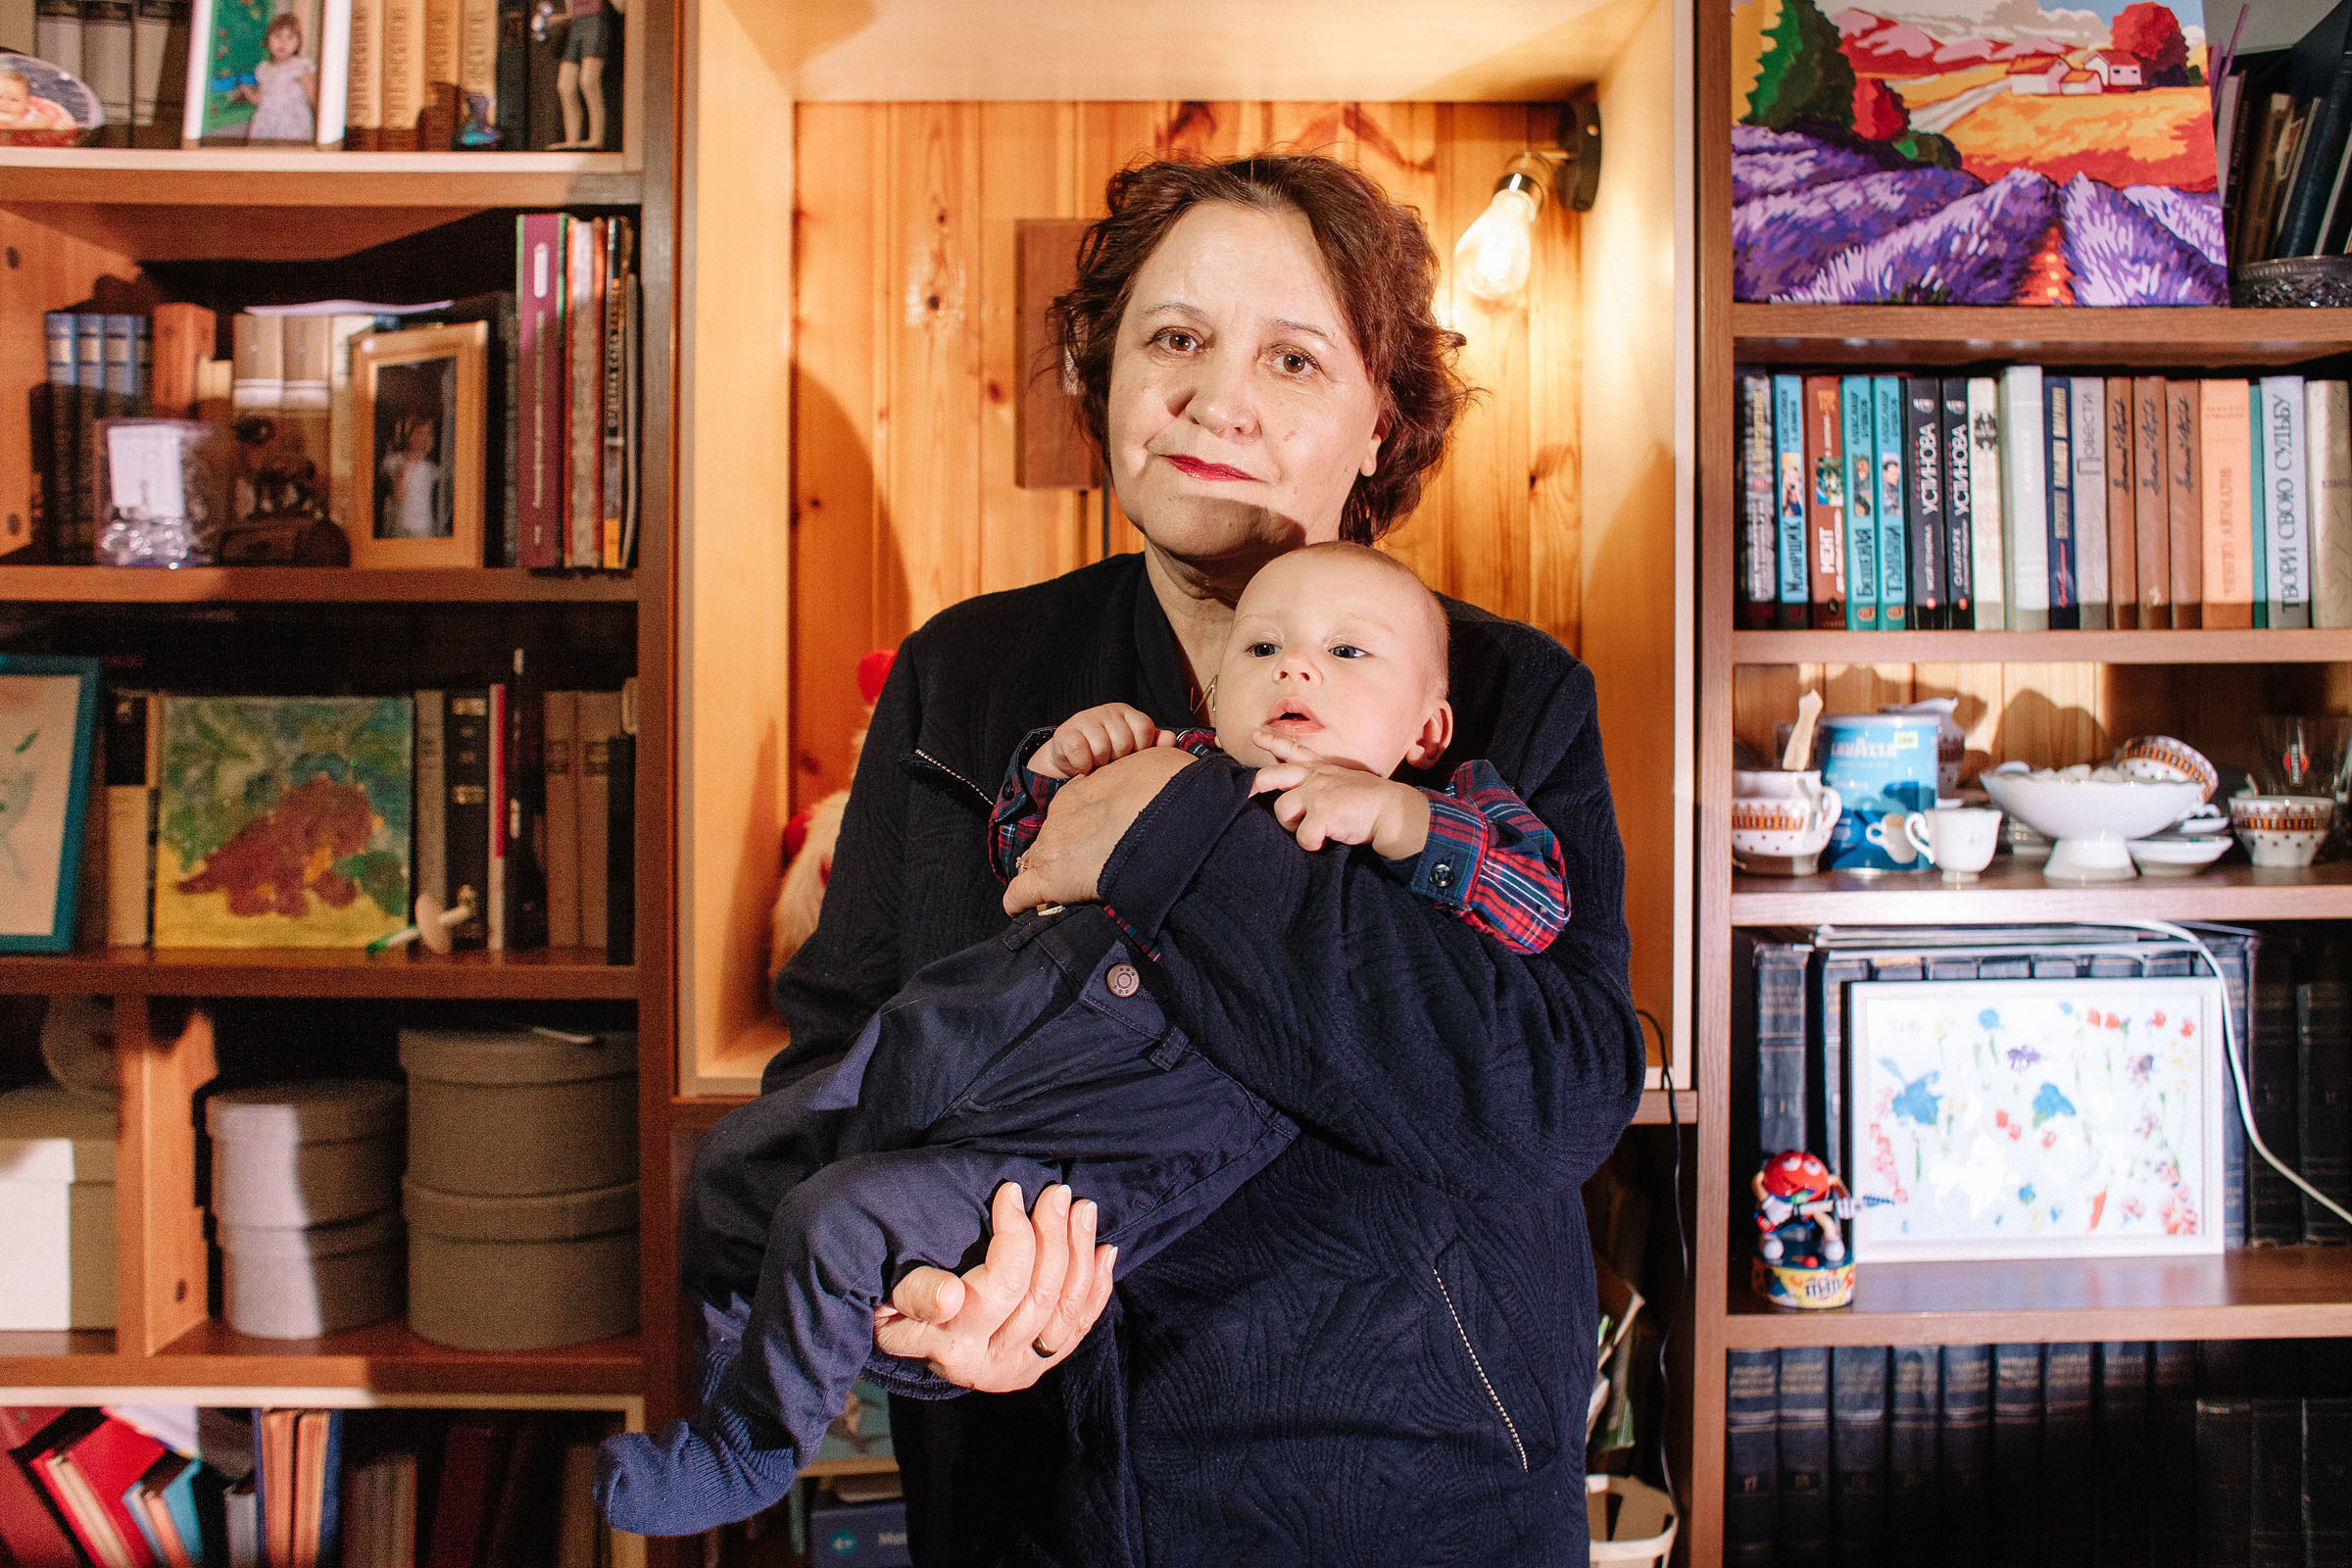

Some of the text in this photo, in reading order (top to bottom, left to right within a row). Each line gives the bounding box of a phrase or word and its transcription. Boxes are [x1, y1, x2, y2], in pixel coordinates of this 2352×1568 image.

[1919, 422, 1938, 515] УСТИНОВА
[1951, 423, 1970, 516] УСТИНОВА
[2272, 393, 2299, 612] ТВОРИ СВОЮ СУДЬБУ
[1819, 527, 1835, 573] МЕНТ
